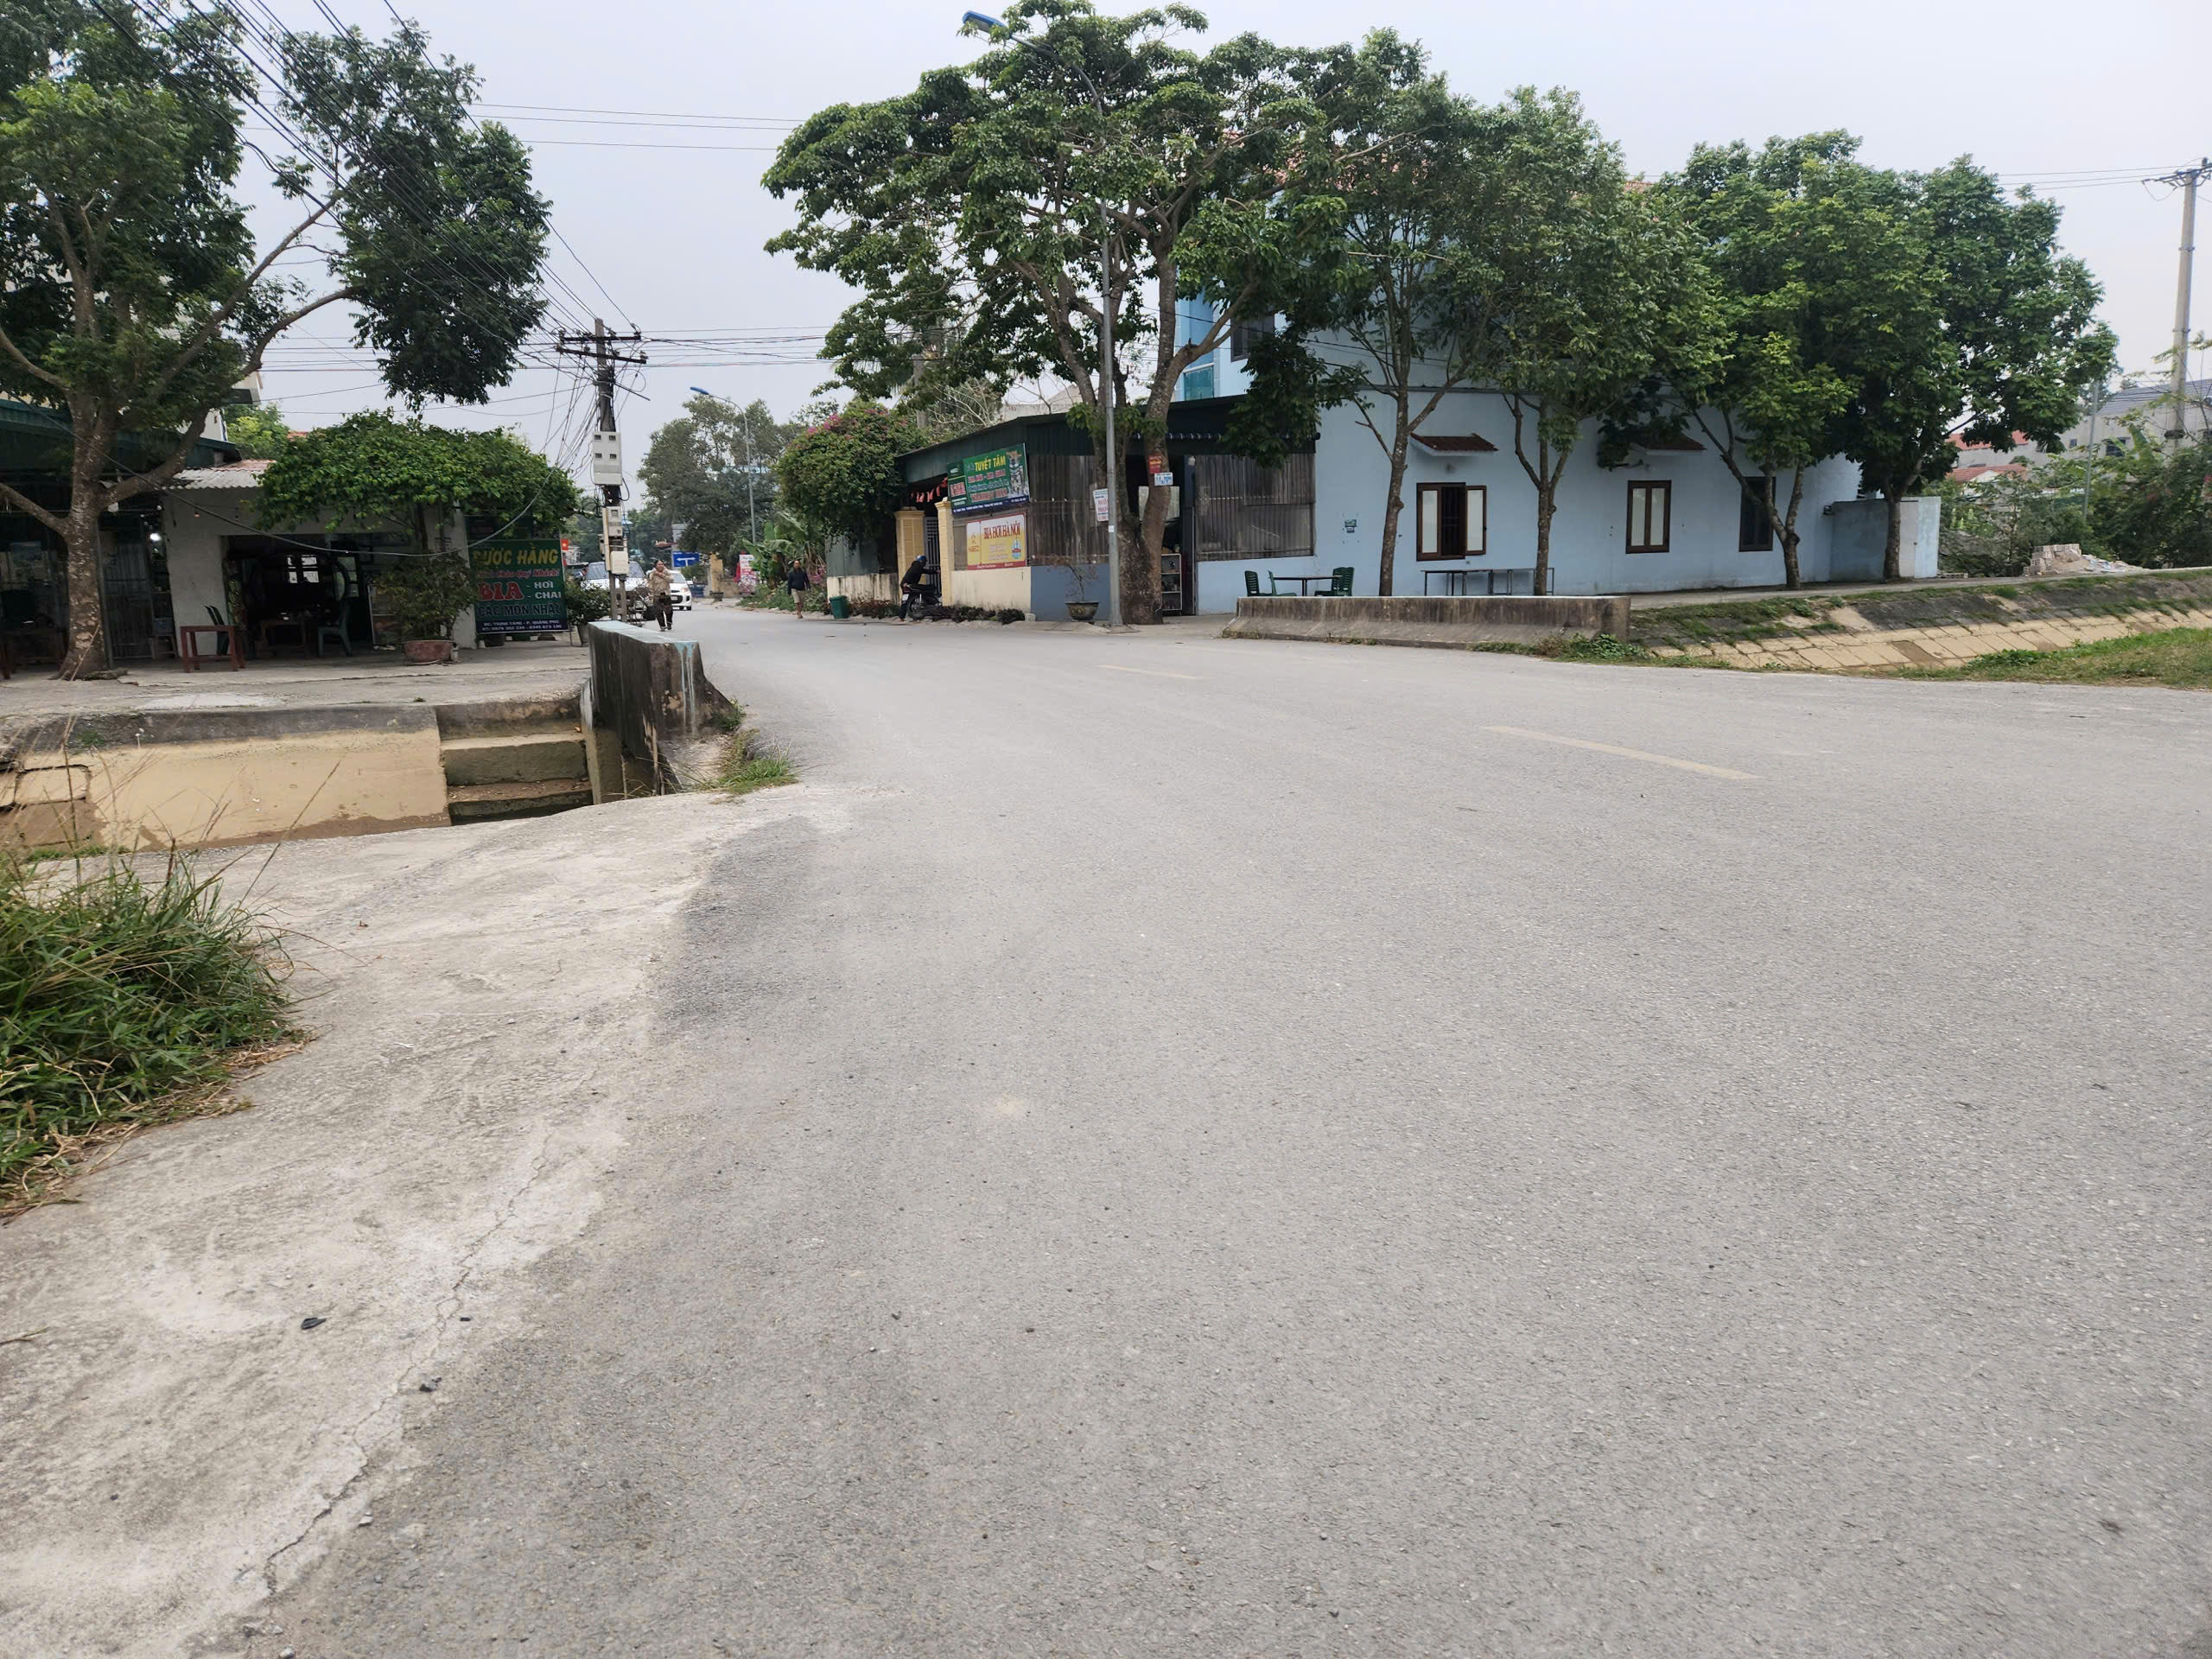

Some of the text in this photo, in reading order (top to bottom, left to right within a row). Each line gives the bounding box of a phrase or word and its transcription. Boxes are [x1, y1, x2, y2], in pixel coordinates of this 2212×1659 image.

[975, 455, 991, 472] TUYẾT
[993, 454, 1007, 467] TÂM
[1002, 520, 1011, 537] HÀ
[1011, 519, 1020, 537] NỘI
[517, 543, 558, 564] HẰNG
[477, 581, 524, 601] BIA
[534, 580, 554, 588] HƠI
[477, 604, 500, 617] CÁC
